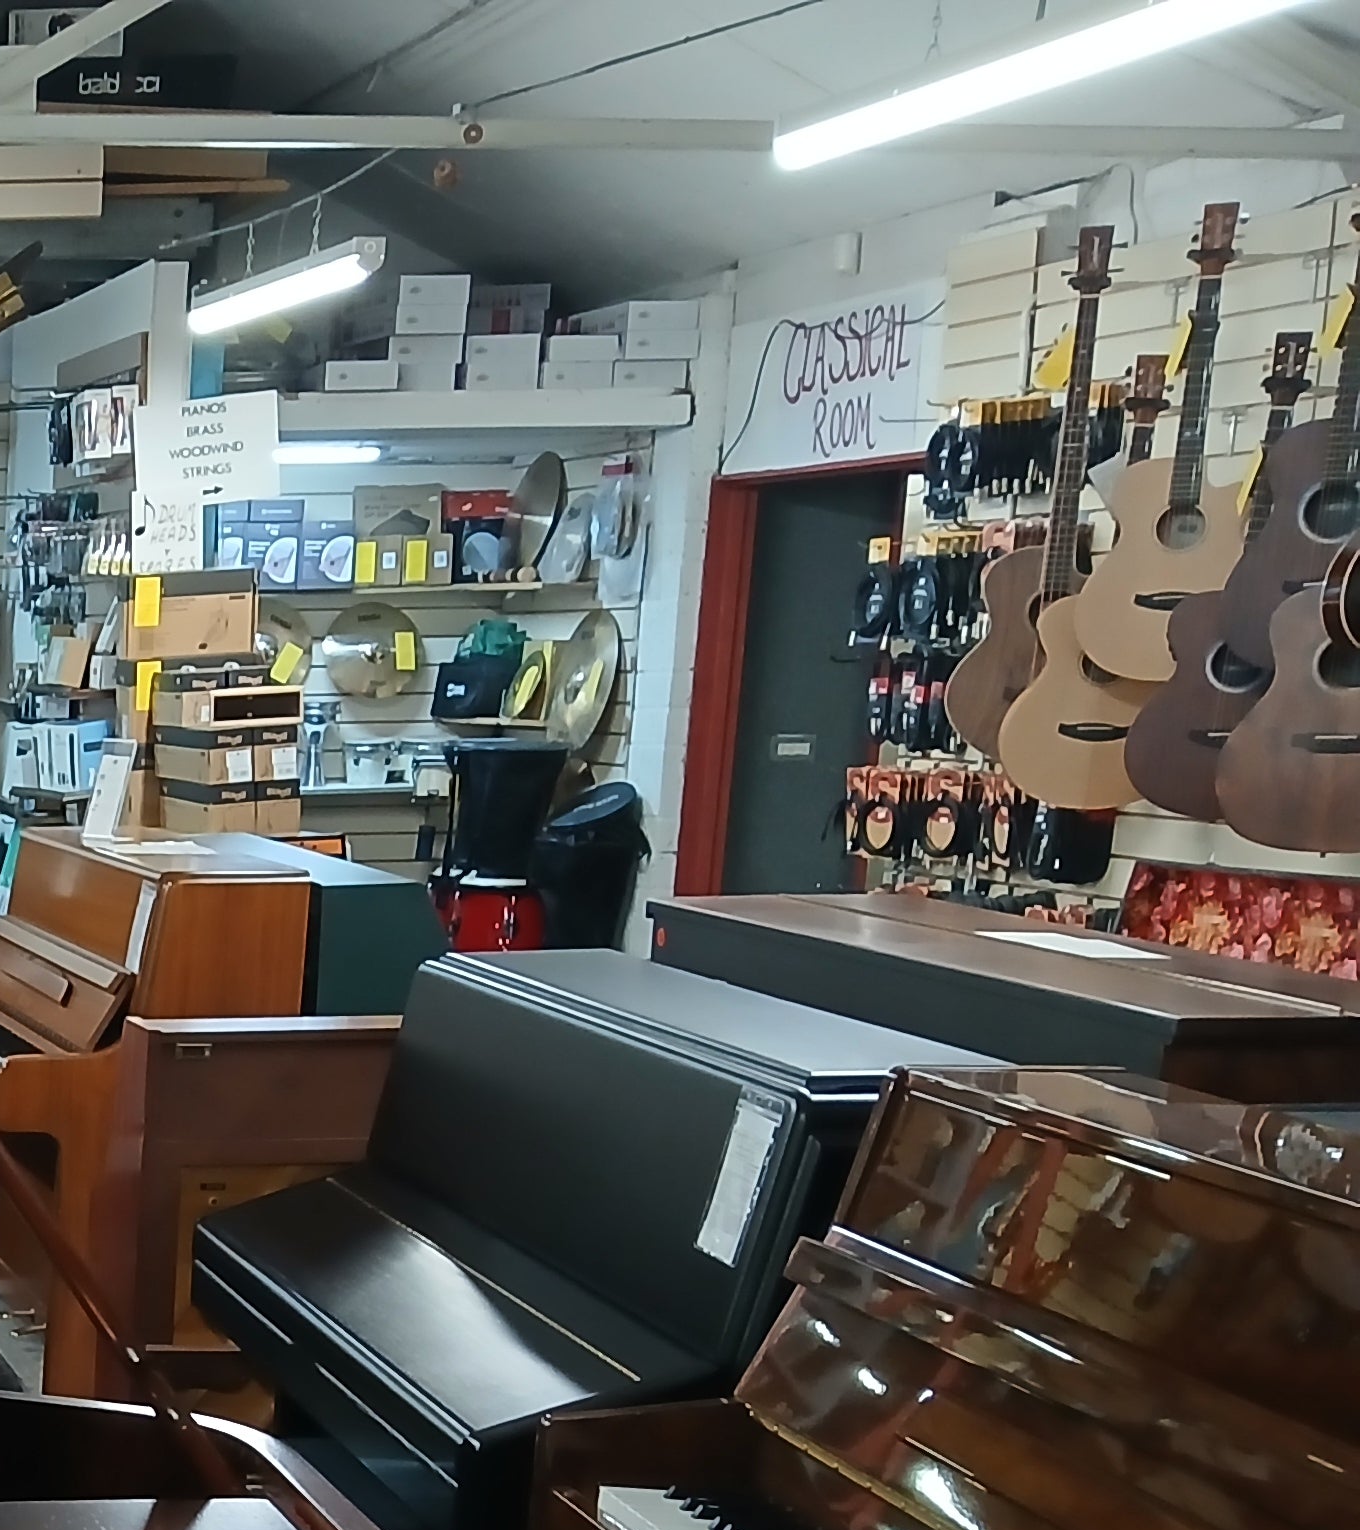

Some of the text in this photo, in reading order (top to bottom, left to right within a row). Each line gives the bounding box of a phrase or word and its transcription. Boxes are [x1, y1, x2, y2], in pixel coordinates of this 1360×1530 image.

[783, 304, 911, 404] CLASSICAL
[181, 402, 227, 417] PIANOS
[186, 423, 224, 437] BRASS
[812, 392, 877, 458] ROOM
[169, 441, 244, 459] WOODWIND
[182, 462, 232, 479] STRINGS
[150, 524, 196, 545] HEADS
